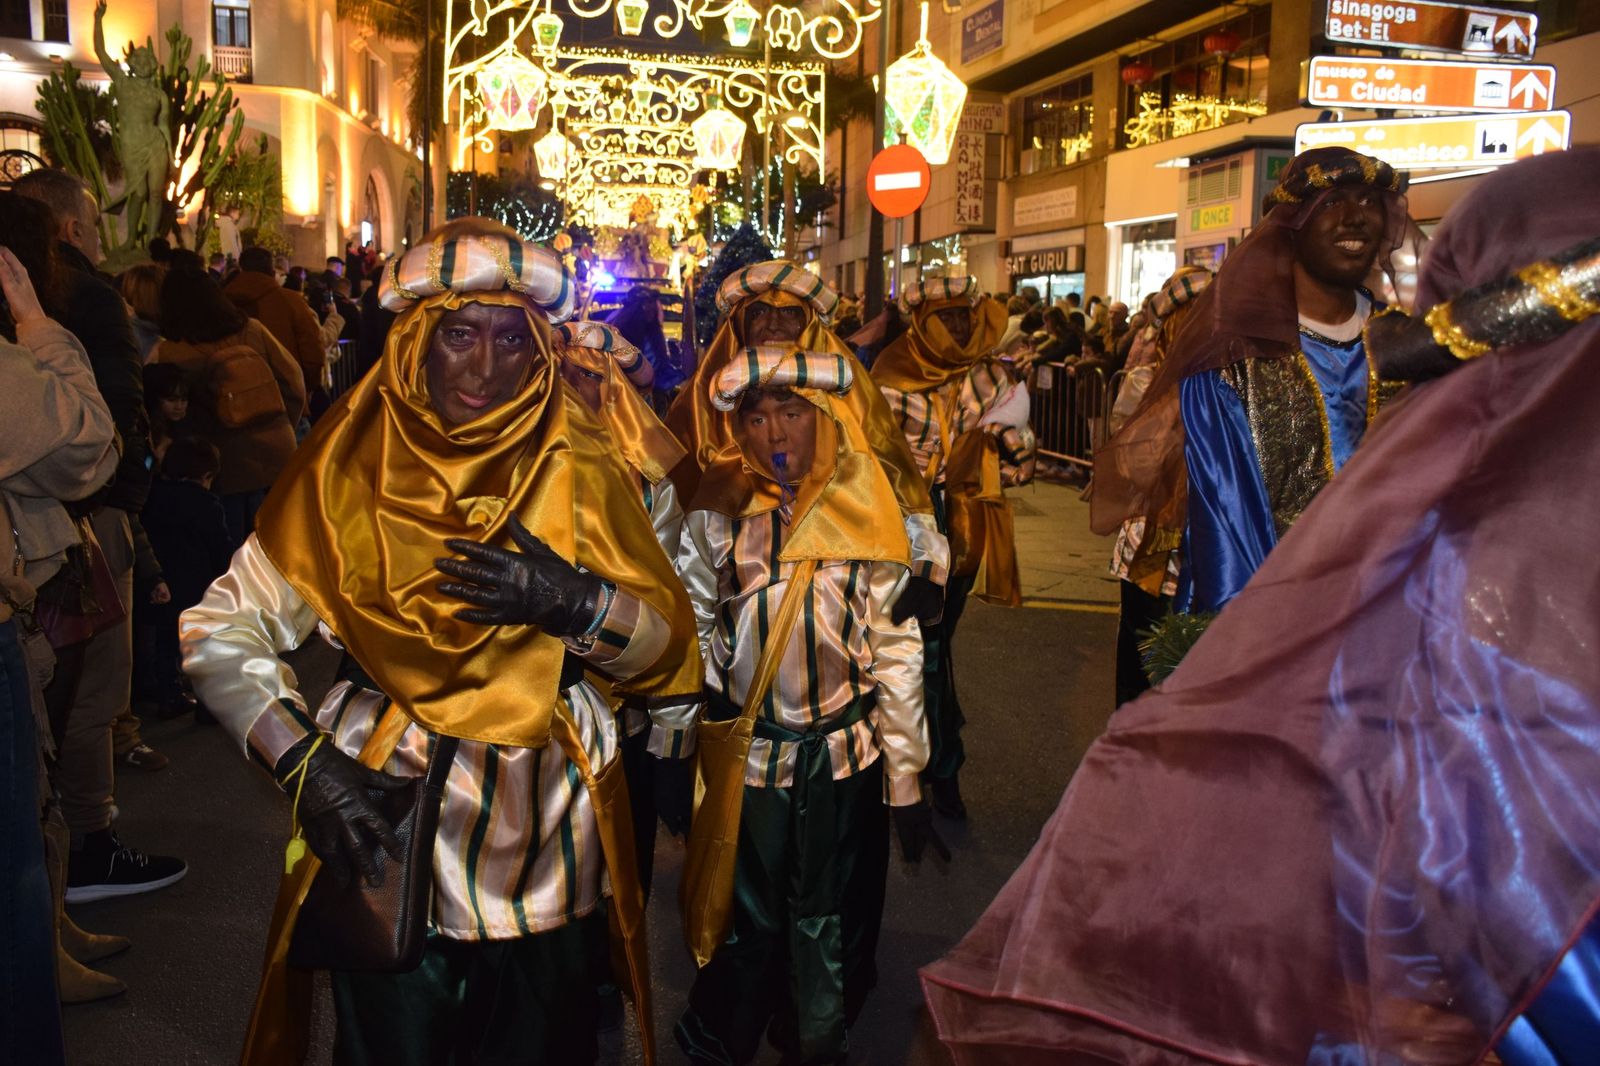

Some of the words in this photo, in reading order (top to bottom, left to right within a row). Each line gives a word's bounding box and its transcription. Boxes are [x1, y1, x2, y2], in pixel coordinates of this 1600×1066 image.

[1331, 0, 1417, 24] sinagoga
[1329, 18, 1390, 41] Bet-El
[1315, 65, 1368, 80] museo
[1374, 65, 1396, 81] de
[1314, 80, 1339, 99] La
[1351, 81, 1427, 103] Ciudad
[959, 117, 993, 130] HINO
[1363, 127, 1386, 142] de
[1203, 206, 1231, 225] ONCE
[1005, 255, 1026, 275] SAT
[1030, 251, 1065, 273] GURU
